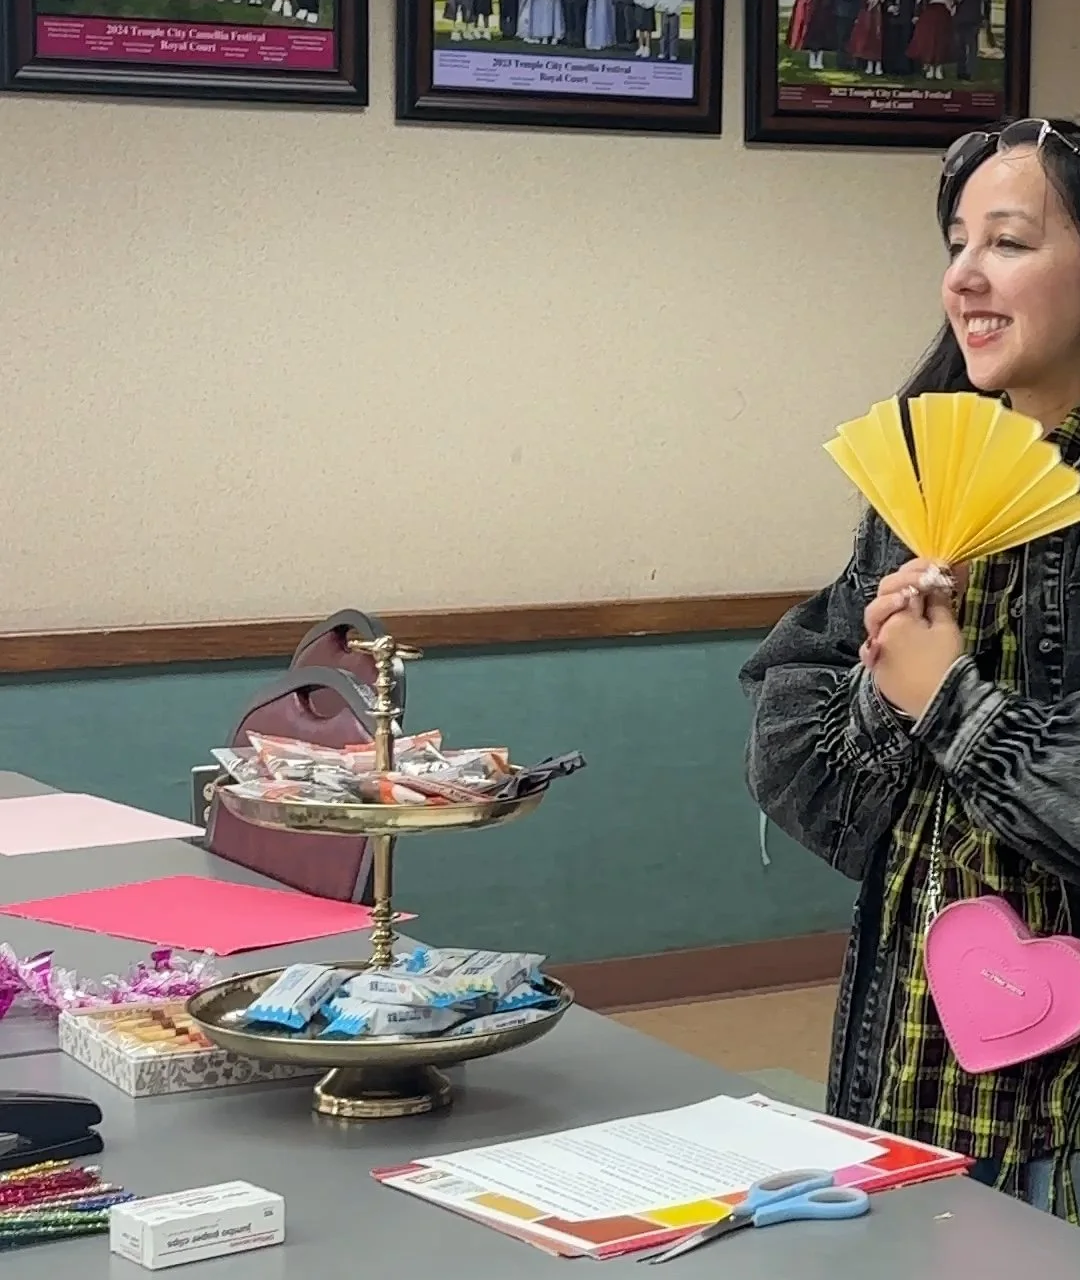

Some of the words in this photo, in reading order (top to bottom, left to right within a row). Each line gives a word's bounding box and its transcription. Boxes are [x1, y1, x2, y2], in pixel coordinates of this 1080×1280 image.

[106, 24, 128, 35] 2024
[130, 25, 165, 39] Temple
[167, 27, 186, 39] City
[189, 28, 229, 41] Camellia
[230, 30, 266, 42] Festival
[160, 40, 187, 52] Royal
[189, 41, 217, 52] Court
[515, 59, 543, 70] Temple
[545, 61, 563, 71] City
[564, 62, 600, 72] Camellia
[601, 64, 632, 74] Festival
[540, 72, 563, 83] Royal
[564, 73, 588, 83] Court
[192, 1229, 220, 1244] paper
[221, 1222, 252, 1237] jumbo
[166, 1236, 190, 1248] clips
